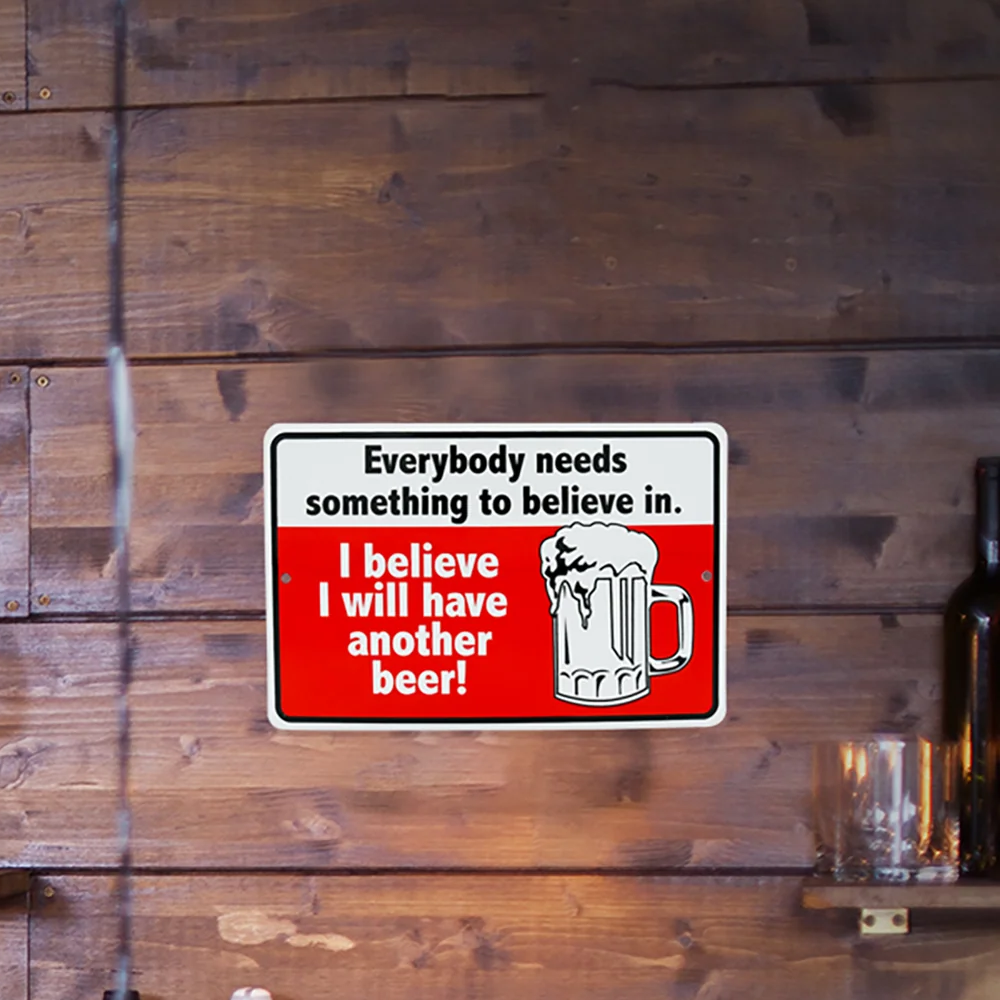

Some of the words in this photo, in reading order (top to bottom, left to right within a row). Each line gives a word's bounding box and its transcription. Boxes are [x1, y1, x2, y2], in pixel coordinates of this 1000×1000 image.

[364, 444, 526, 484] Everybody
[536, 443, 628, 474] needs
[306, 485, 469, 525] something
[478, 488, 512, 516] to
[522, 484, 634, 516] believe
[644, 484, 682, 514] in.
[340, 543, 349, 578] I
[363, 541, 500, 579] believe
[320, 582, 329, 616] I
[341, 581, 409, 618] will
[422, 581, 508, 618] have
[347, 620, 493, 657] another
[371, 659, 467, 696] beer!
